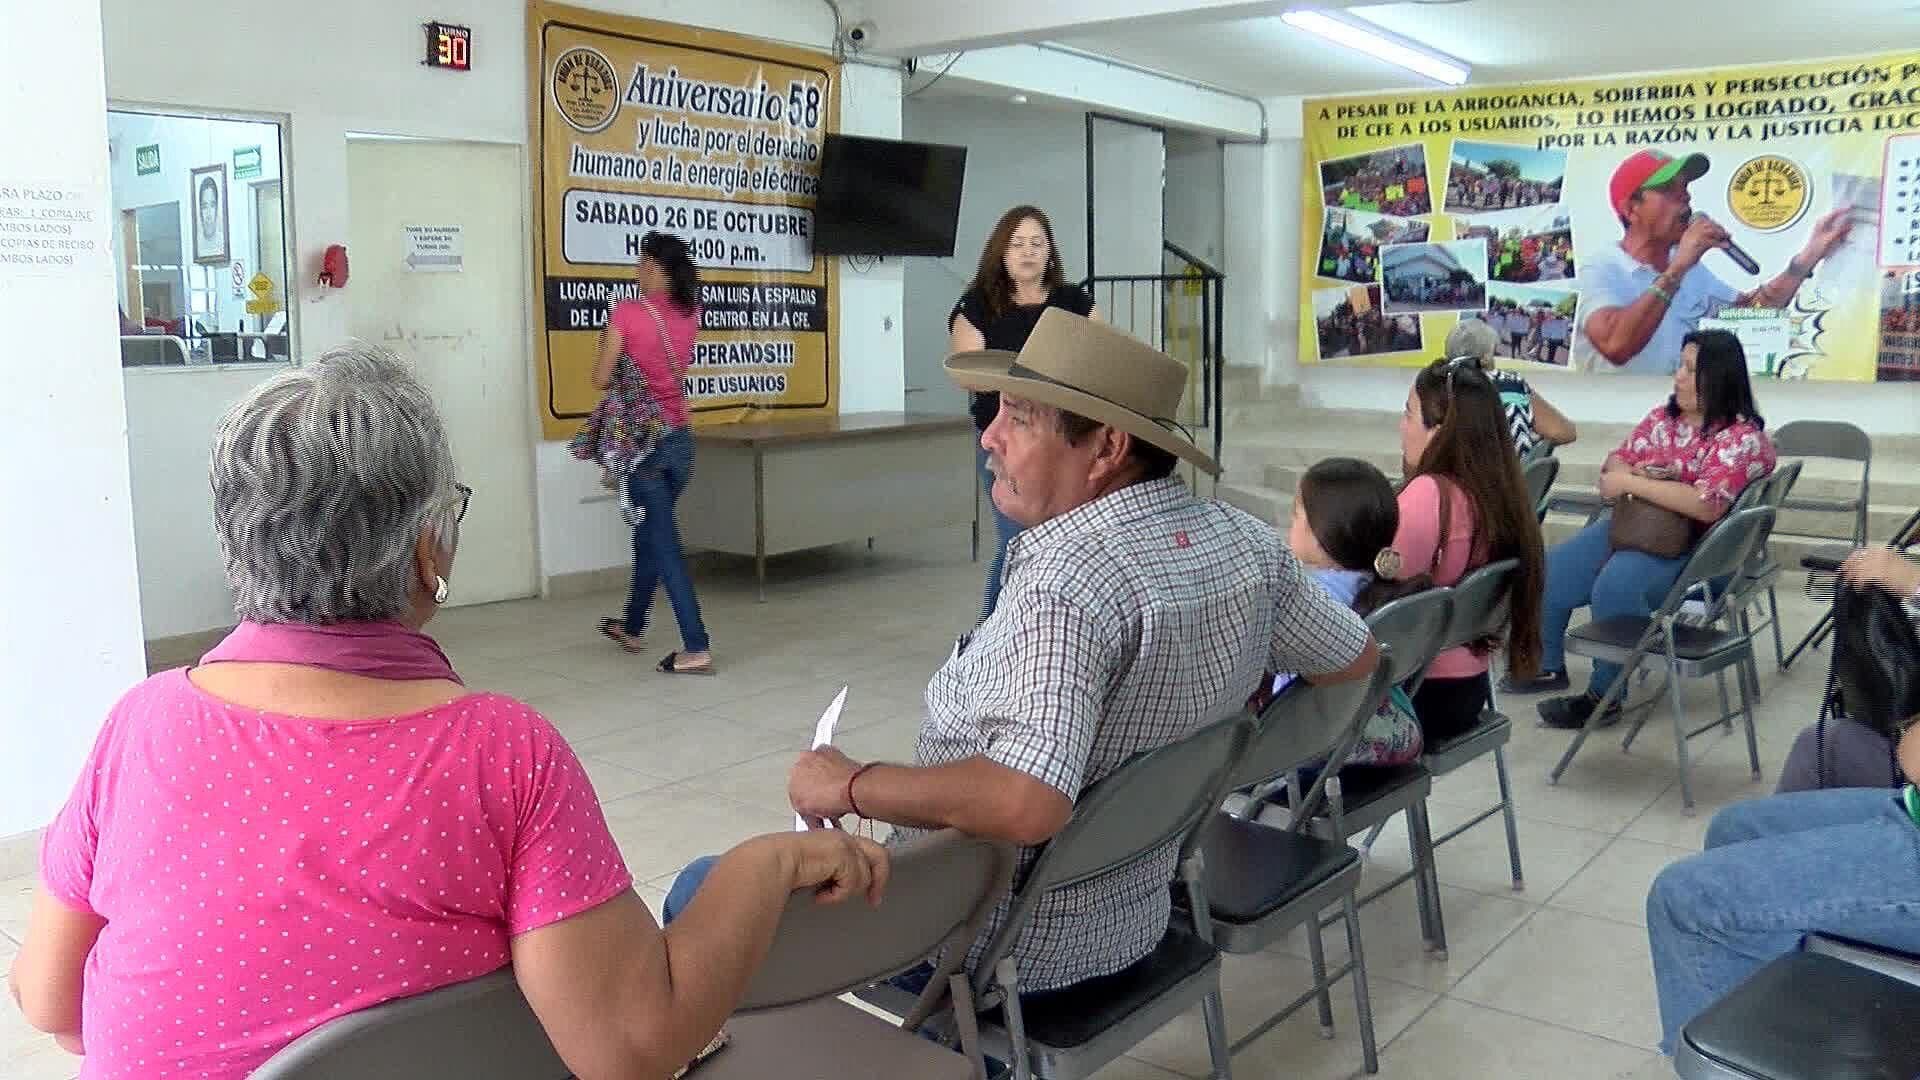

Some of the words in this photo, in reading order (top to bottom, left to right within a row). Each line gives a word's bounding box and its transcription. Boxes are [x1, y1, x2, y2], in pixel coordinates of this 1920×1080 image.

[439, 27, 468, 38] TURNO
[438, 34, 467, 65] 30
[626, 66, 784, 121] Aniversario
[787, 83, 820, 128] 58
[1319, 106, 1331, 120] A
[1337, 102, 1389, 119] PESAR
[1395, 101, 1416, 115] DE
[1424, 99, 1446, 114] LA
[1452, 91, 1585, 112] ARROGANCIA,
[1593, 83, 1696, 103] SOBERBIA
[1705, 81, 1718, 97] Y
[1725, 64, 1890, 94] PERSECUCIÓN
[1337, 125, 1359, 139] DE
[1365, 122, 1393, 137] CFE
[1400, 121, 1412, 135] A
[1420, 119, 1452, 134] LOS
[1459, 114, 1561, 132] USUARIOS,
[1576, 110, 1604, 126] LO
[1614, 103, 1696, 124] HEMOS
[1705, 95, 1836, 118] LOGRADO,
[1594, 131, 1617, 146] LA
[1625, 123, 1698, 144] RAZÓN
[1707, 125, 1719, 141] Y
[1727, 125, 1753, 140] LA
[1761, 117, 1863, 141] JUSTICIA
[638, 121, 650, 149] y
[654, 117, 700, 148] lucha
[705, 129, 733, 156] por
[737, 129, 752, 154] el
[753, 131, 818, 161] derecho
[572, 145, 647, 179] humano
[652, 160, 662, 181] a
[668, 155, 683, 183] la
[688, 162, 749, 194] energía
[752, 165, 820, 196] eléctrica
[575, 200, 659, 226] SABADO
[665, 206, 688, 230] 26
[693, 208, 718, 231] DE
[723, 210, 809, 238] OCTUBRE
[731, 241, 766, 265] p.m.
[560, 281, 609, 301] LUGAR:
[702, 285, 725, 303] SAN
[727, 286, 750, 304] LUIS
[752, 286, 761, 304] A
[765, 286, 817, 305] ESPALDAS
[570, 308, 590, 327] DE
[593, 308, 608, 327] LA
[752, 311, 769, 327] EN
[773, 311, 791, 328] LA
[698, 377, 716, 394] DE
[719, 375, 785, 394] USUARIOS
